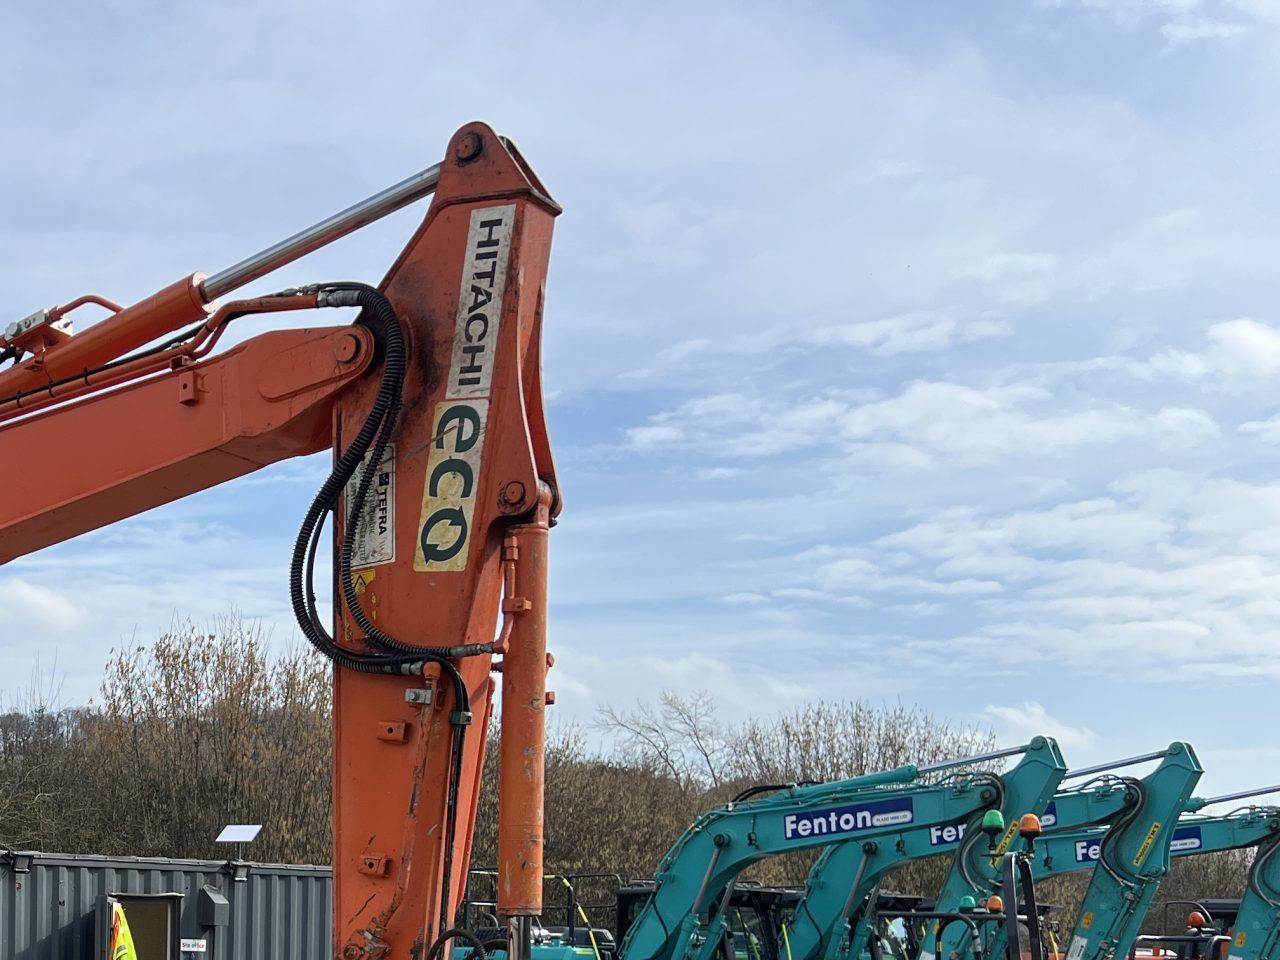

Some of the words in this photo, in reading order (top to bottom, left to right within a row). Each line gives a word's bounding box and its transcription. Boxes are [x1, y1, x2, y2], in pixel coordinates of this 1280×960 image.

[457, 218, 503, 387] HITACHI
[378, 489, 387, 536] TEFRA
[421, 404, 481, 565] eco
[785, 811, 872, 838] Fenton
